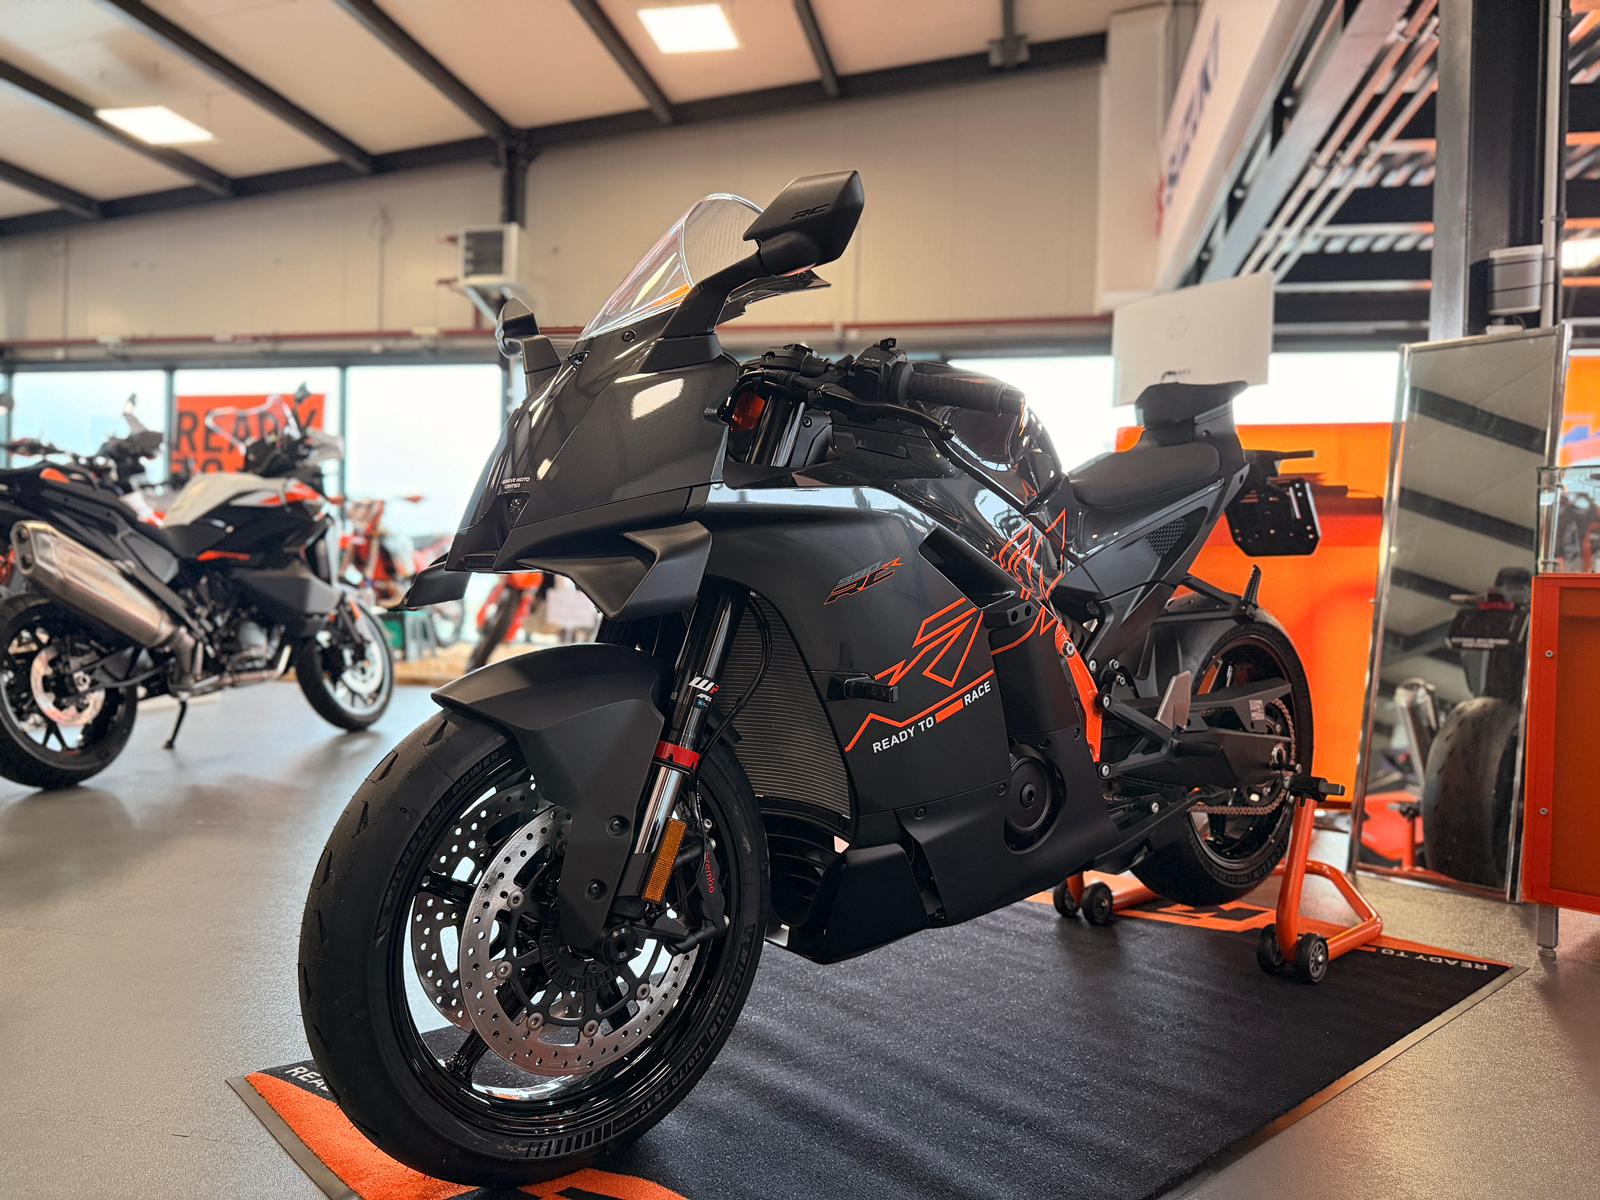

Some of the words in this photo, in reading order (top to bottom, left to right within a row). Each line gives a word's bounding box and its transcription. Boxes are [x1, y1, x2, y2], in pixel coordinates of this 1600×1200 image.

[872, 725, 915, 754] READY
[917, 715, 935, 732] TO
[963, 681, 992, 706] RACE
[1381, 948, 1408, 958] TO
[1415, 954, 1487, 970] READY
[285, 1065, 330, 1092] REA
